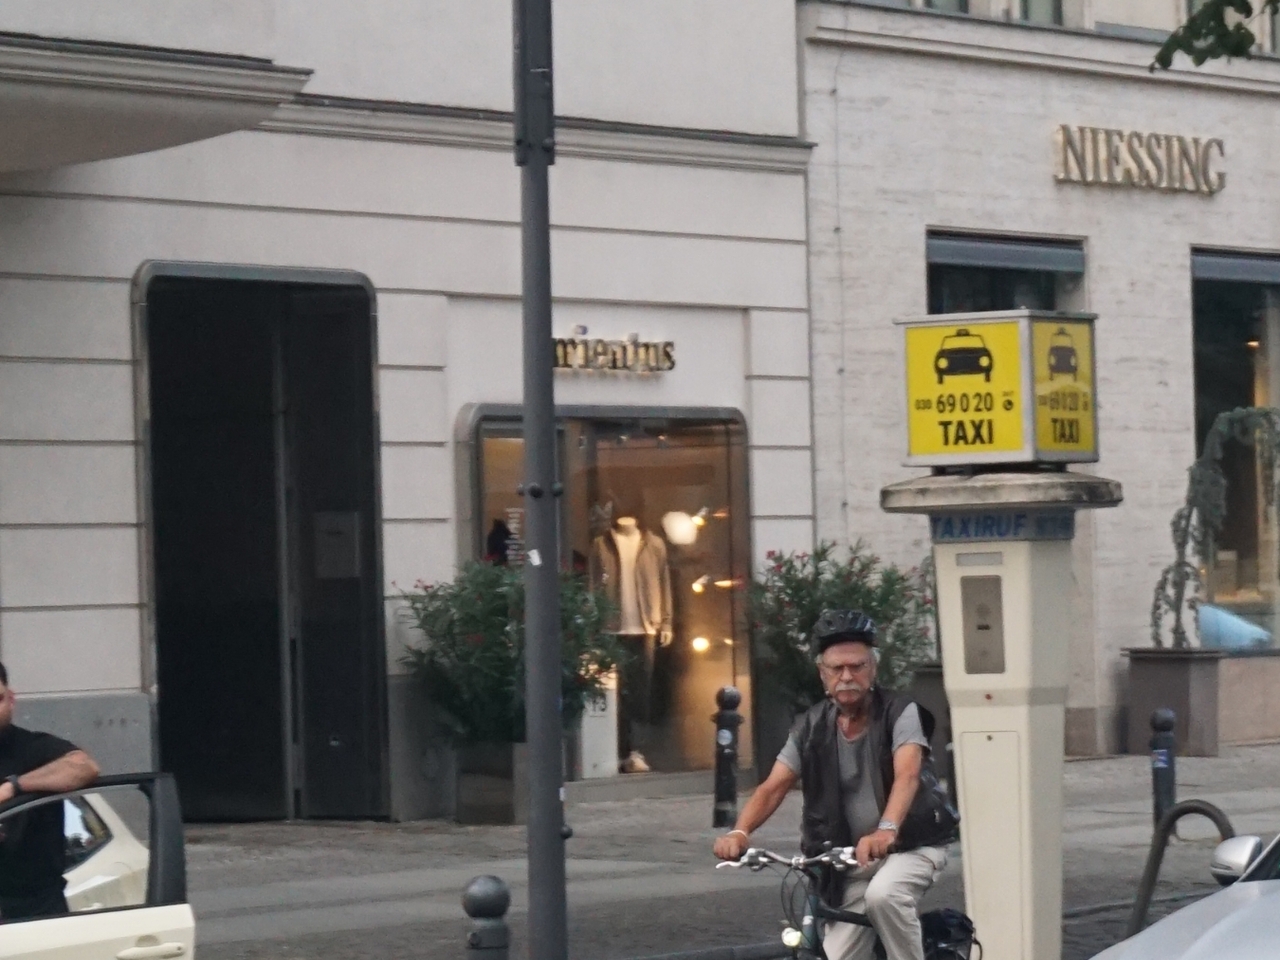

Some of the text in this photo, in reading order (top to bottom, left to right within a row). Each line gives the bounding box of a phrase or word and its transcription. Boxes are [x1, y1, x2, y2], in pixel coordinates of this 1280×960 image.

[1053, 124, 1227, 196] NIESSING
[938, 419, 994, 446] TAXI
[1051, 418, 1079, 444] TAXI
[930, 513, 1027, 539] TAXIRUF
